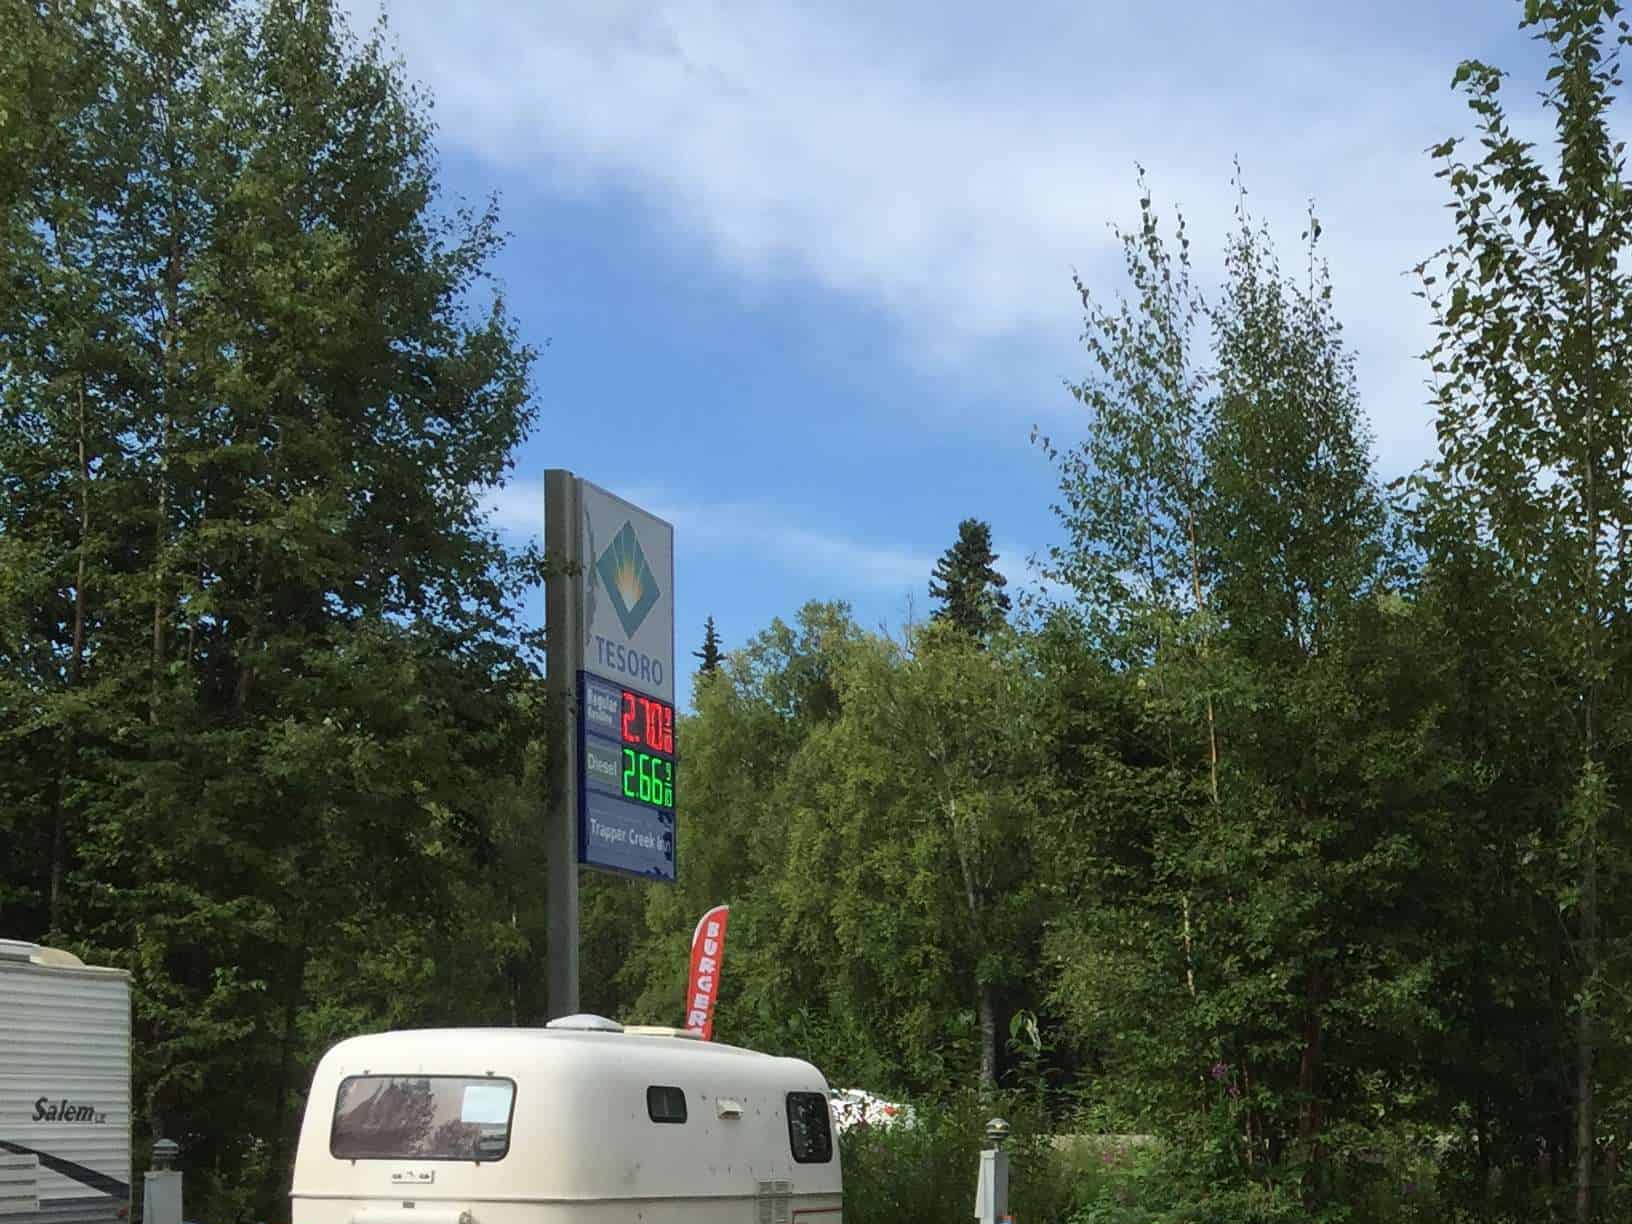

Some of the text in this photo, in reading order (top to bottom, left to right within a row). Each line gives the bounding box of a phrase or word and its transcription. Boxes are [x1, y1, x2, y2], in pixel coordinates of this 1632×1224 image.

[595, 635, 663, 685] TESORO
[624, 692, 662, 750] 2.70
[587, 753, 617, 776] Diesel
[624, 748, 662, 805] 2.66
[590, 817, 626, 844] Trapper
[629, 827, 656, 849] Creek
[32, 1096, 95, 1121] Salem
